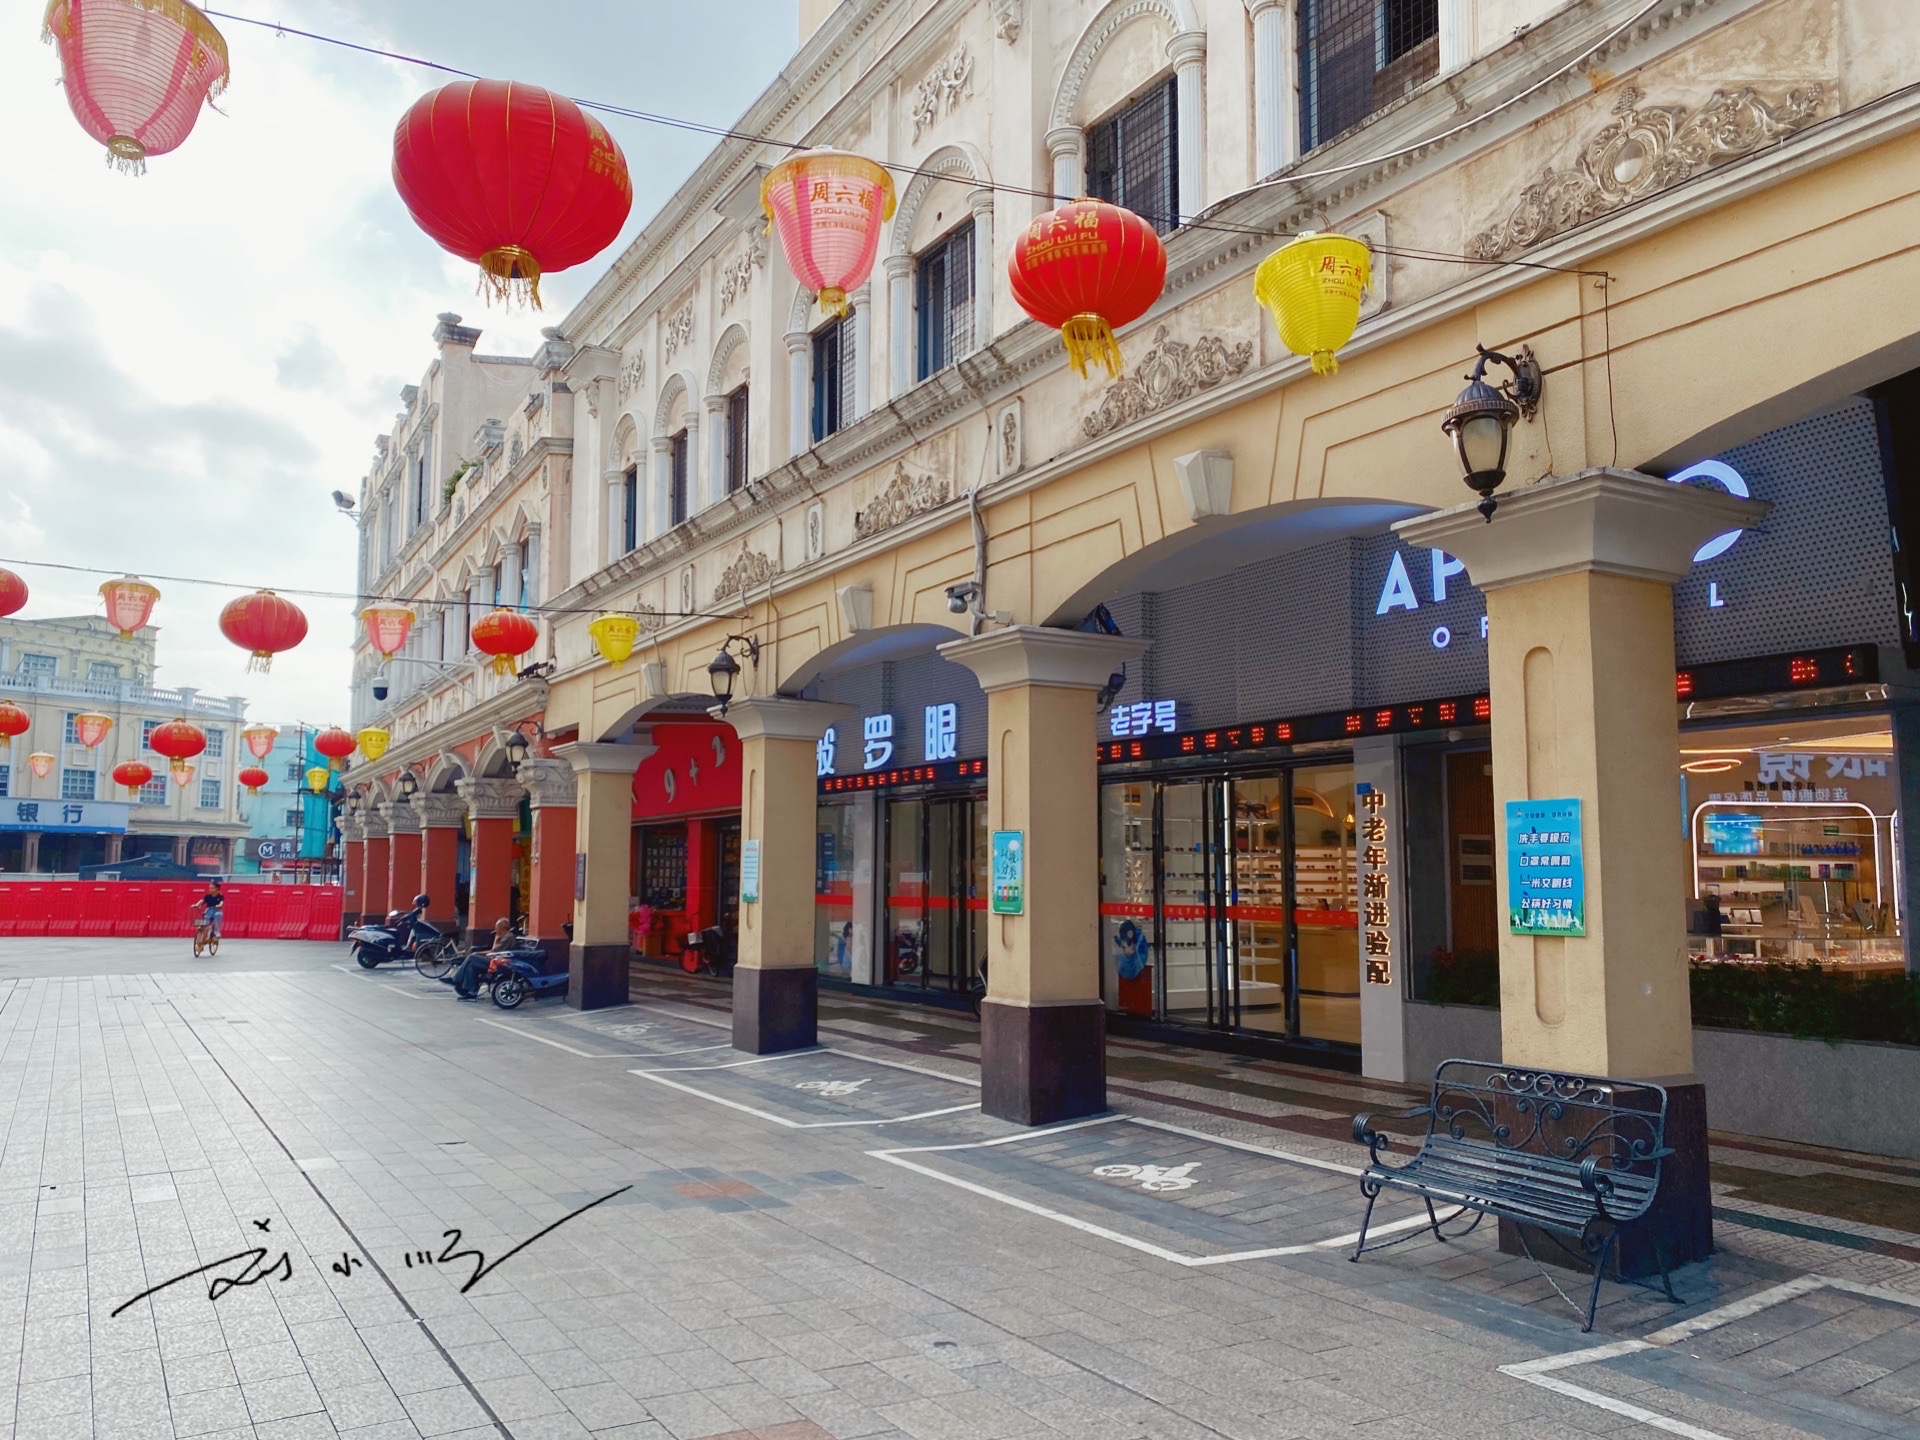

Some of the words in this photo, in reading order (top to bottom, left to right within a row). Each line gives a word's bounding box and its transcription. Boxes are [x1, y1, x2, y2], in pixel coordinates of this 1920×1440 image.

[811, 182, 874, 213] 周六福
[813, 207, 842, 215] ZHOU
[1024, 211, 1099, 246] 周六福
[1026, 238, 1054, 256] ZHOU
[1058, 232, 1077, 244] LIU
[1081, 231, 1098, 240] FU
[1322, 277, 1345, 285] ZHOU
[1110, 699, 1176, 737] 老字号
[16, 801, 84, 824] 银行
[1519, 832, 1571, 844] 洗手要规范
[1520, 855, 1571, 867] 口罩常佩戴
[1361, 787, 1392, 985] 中老年渐进验配
[1521, 878, 1573, 889] 一米文明线
[1521, 898, 1573, 910] 公筷好习惯
